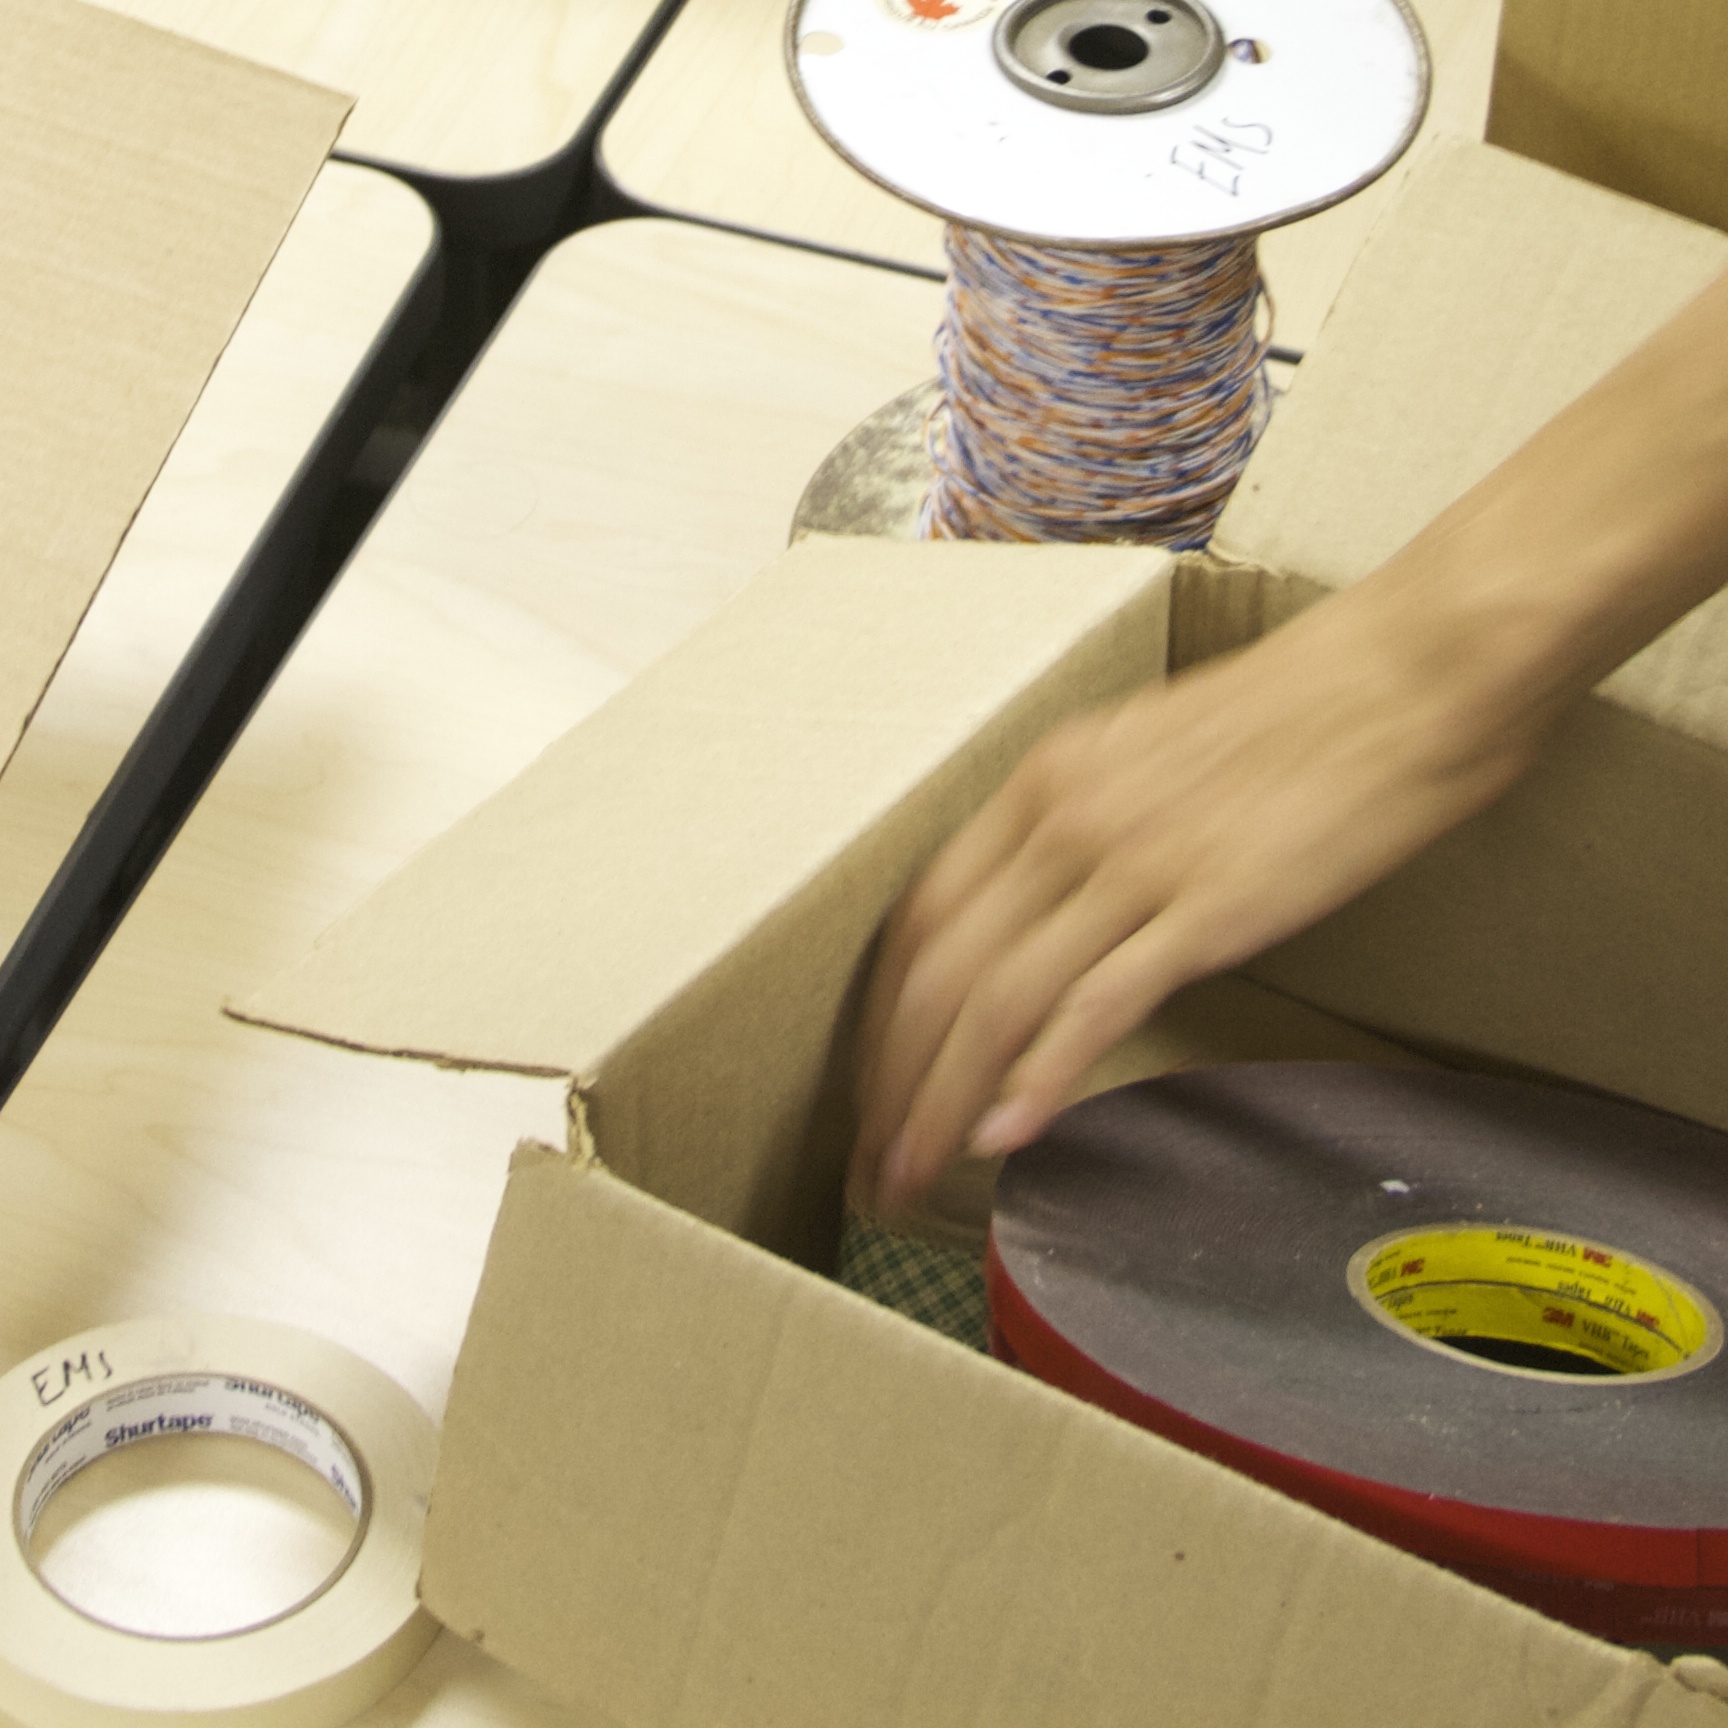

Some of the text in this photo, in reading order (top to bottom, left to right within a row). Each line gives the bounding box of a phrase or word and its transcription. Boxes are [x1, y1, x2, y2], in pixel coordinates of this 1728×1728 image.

[1169, 114, 1274, 198] EMS
[31, 1348, 113, 1407] EMS
[104, 1412, 215, 1448] Shurtape
